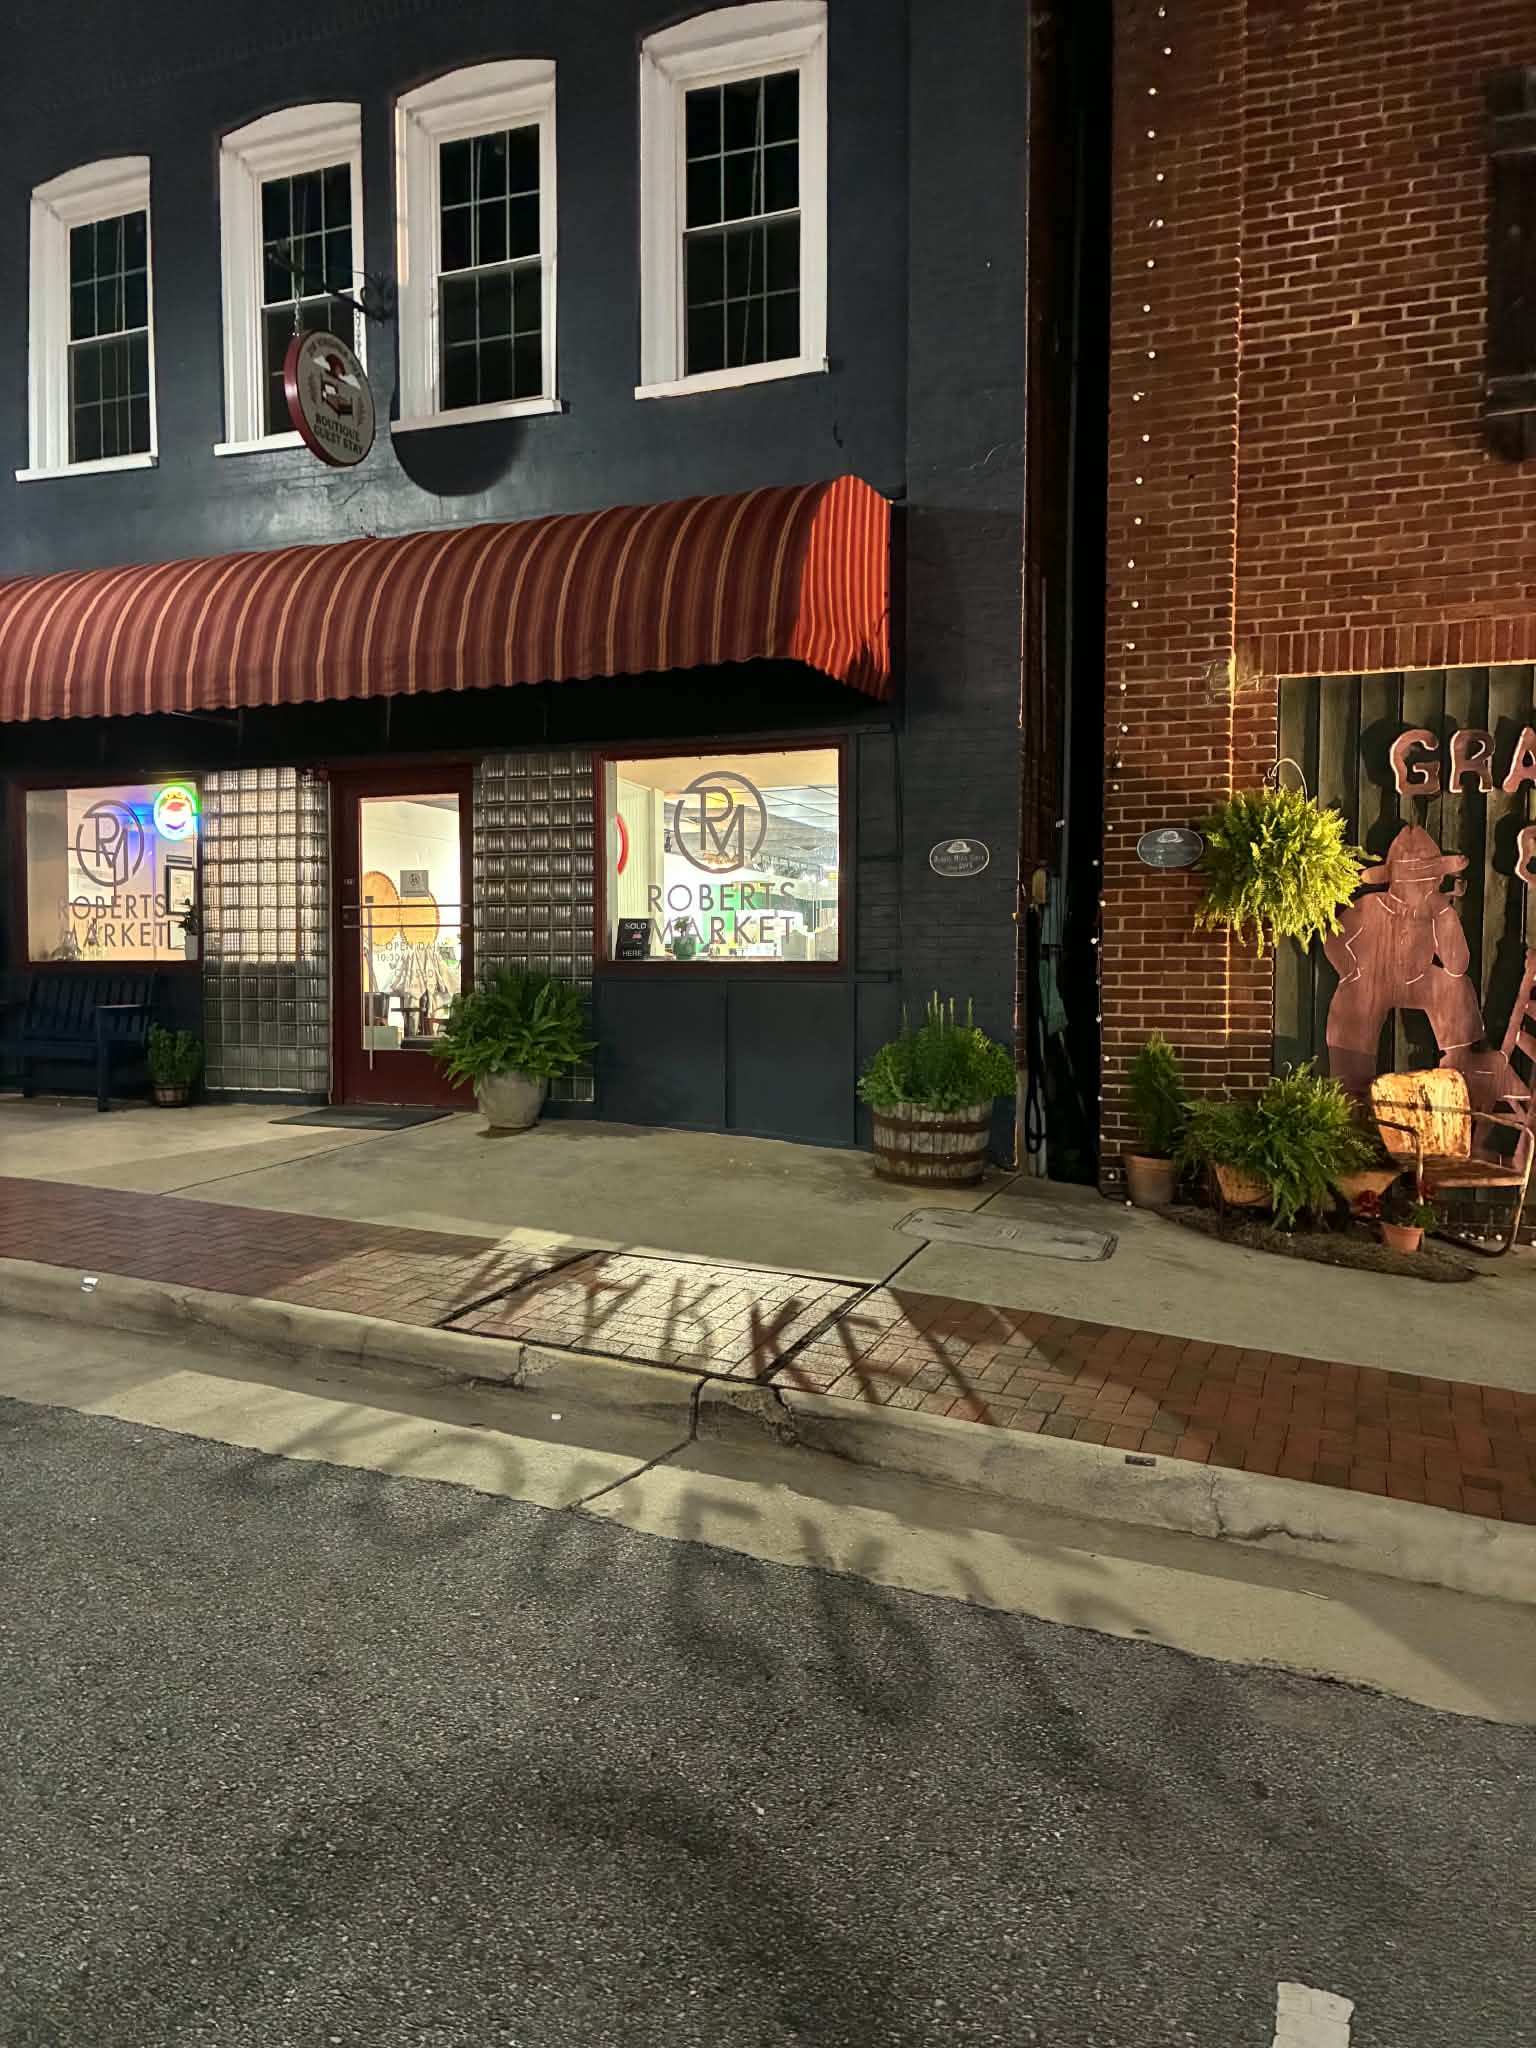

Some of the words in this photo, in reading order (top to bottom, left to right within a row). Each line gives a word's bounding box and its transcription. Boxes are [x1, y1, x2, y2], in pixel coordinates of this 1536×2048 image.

[58, 894, 166, 919] ROBERTS
[647, 881, 796, 913] ROBERTS
[62, 921, 167, 947] MARKET
[624, 922, 647, 930] SOLD
[648, 916, 796, 945] MARKET
[622, 949, 642, 957] HERE
